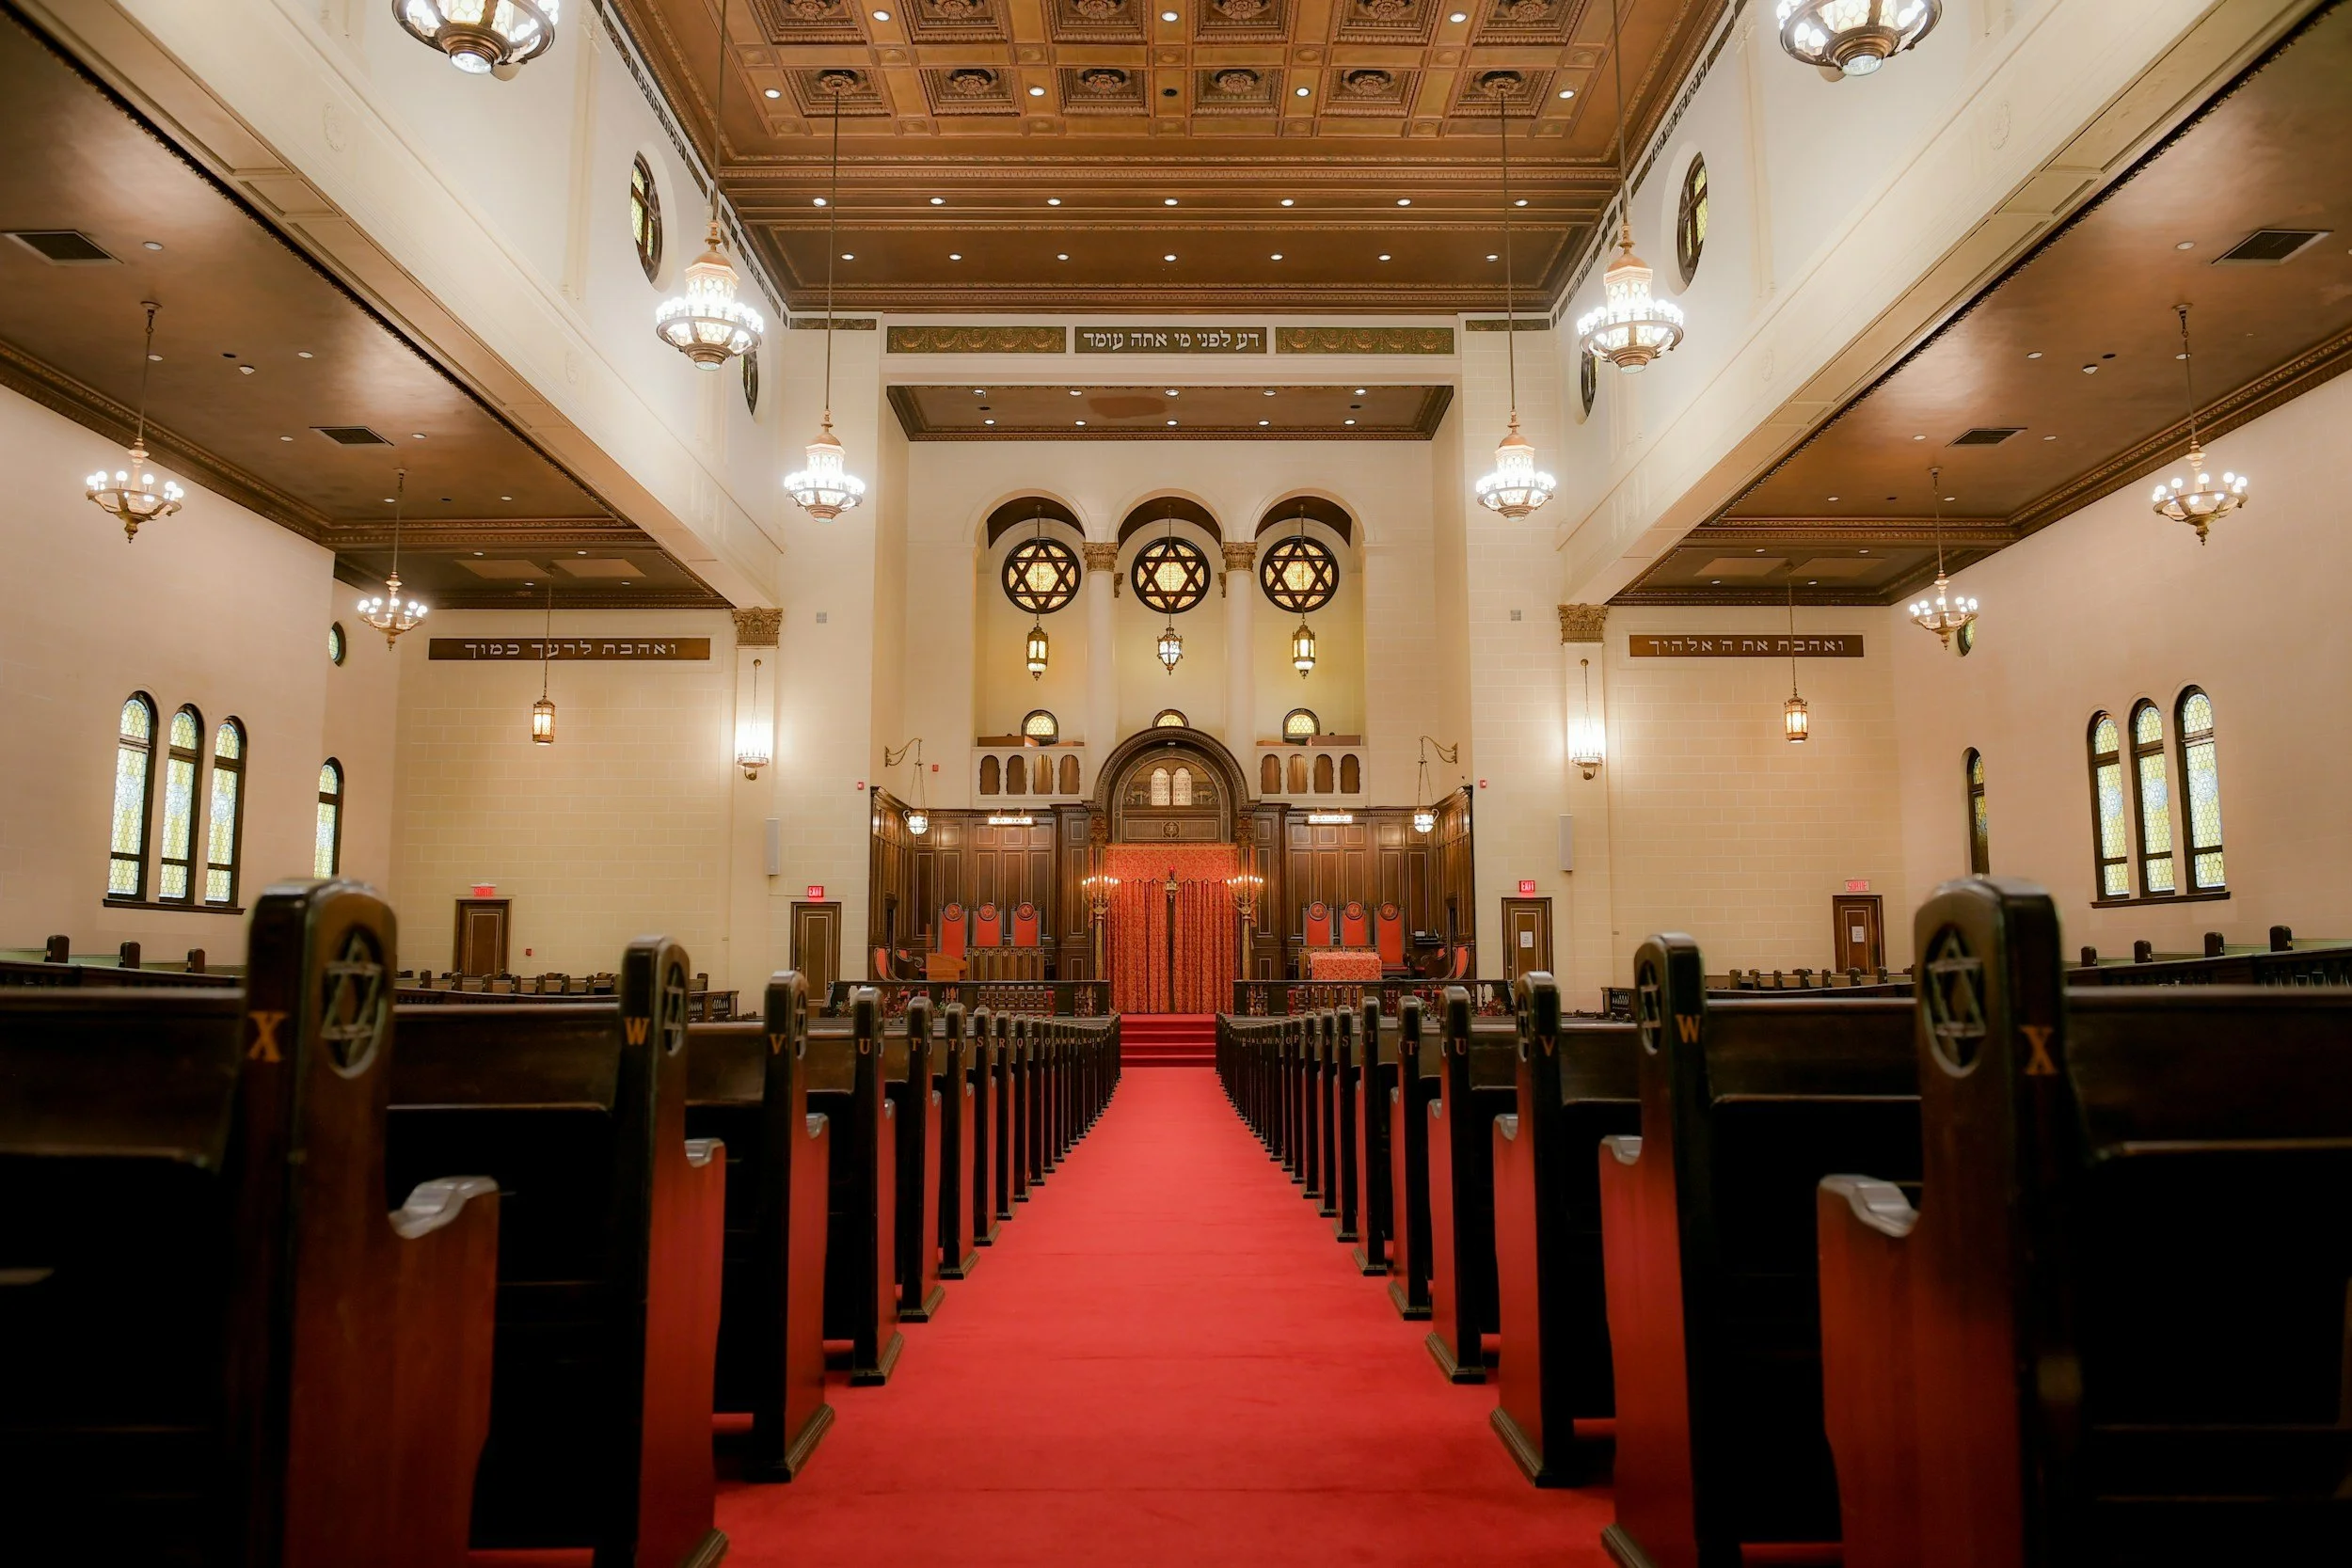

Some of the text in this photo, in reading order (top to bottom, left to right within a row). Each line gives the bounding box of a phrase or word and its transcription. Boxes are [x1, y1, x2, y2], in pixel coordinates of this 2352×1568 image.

[1083, 329, 1260, 351] דע לפני מי אתה עומד
[464, 640, 677, 659] ואהבת לרעך כמוך
[1648, 636, 1713, 656] אלהיך
[1741, 640, 1769, 653] את
[1777, 640, 1845, 653] ואהבת
[1520, 881, 1534, 892] EXIT
[247, 1010, 287, 1063] X
[623, 1016, 650, 1046] W
[1367, 1030, 1375, 1043] T
[1675, 1014, 1701, 1043] W
[770, 1034, 787, 1054] V
[858, 1038, 871, 1054] U
[948, 1037, 958, 1052] T
[977, 1036, 984, 1048] S
[998, 1037, 1006, 1048] R
[1016, 1037, 1025, 1050] Q
[1033, 1037, 1040, 1046] P
[1342, 1036, 1349, 1047] S
[1454, 1037, 1467, 1055] U
[1539, 1036, 1555, 1056] V
[2017, 1024, 2058, 1076] X
